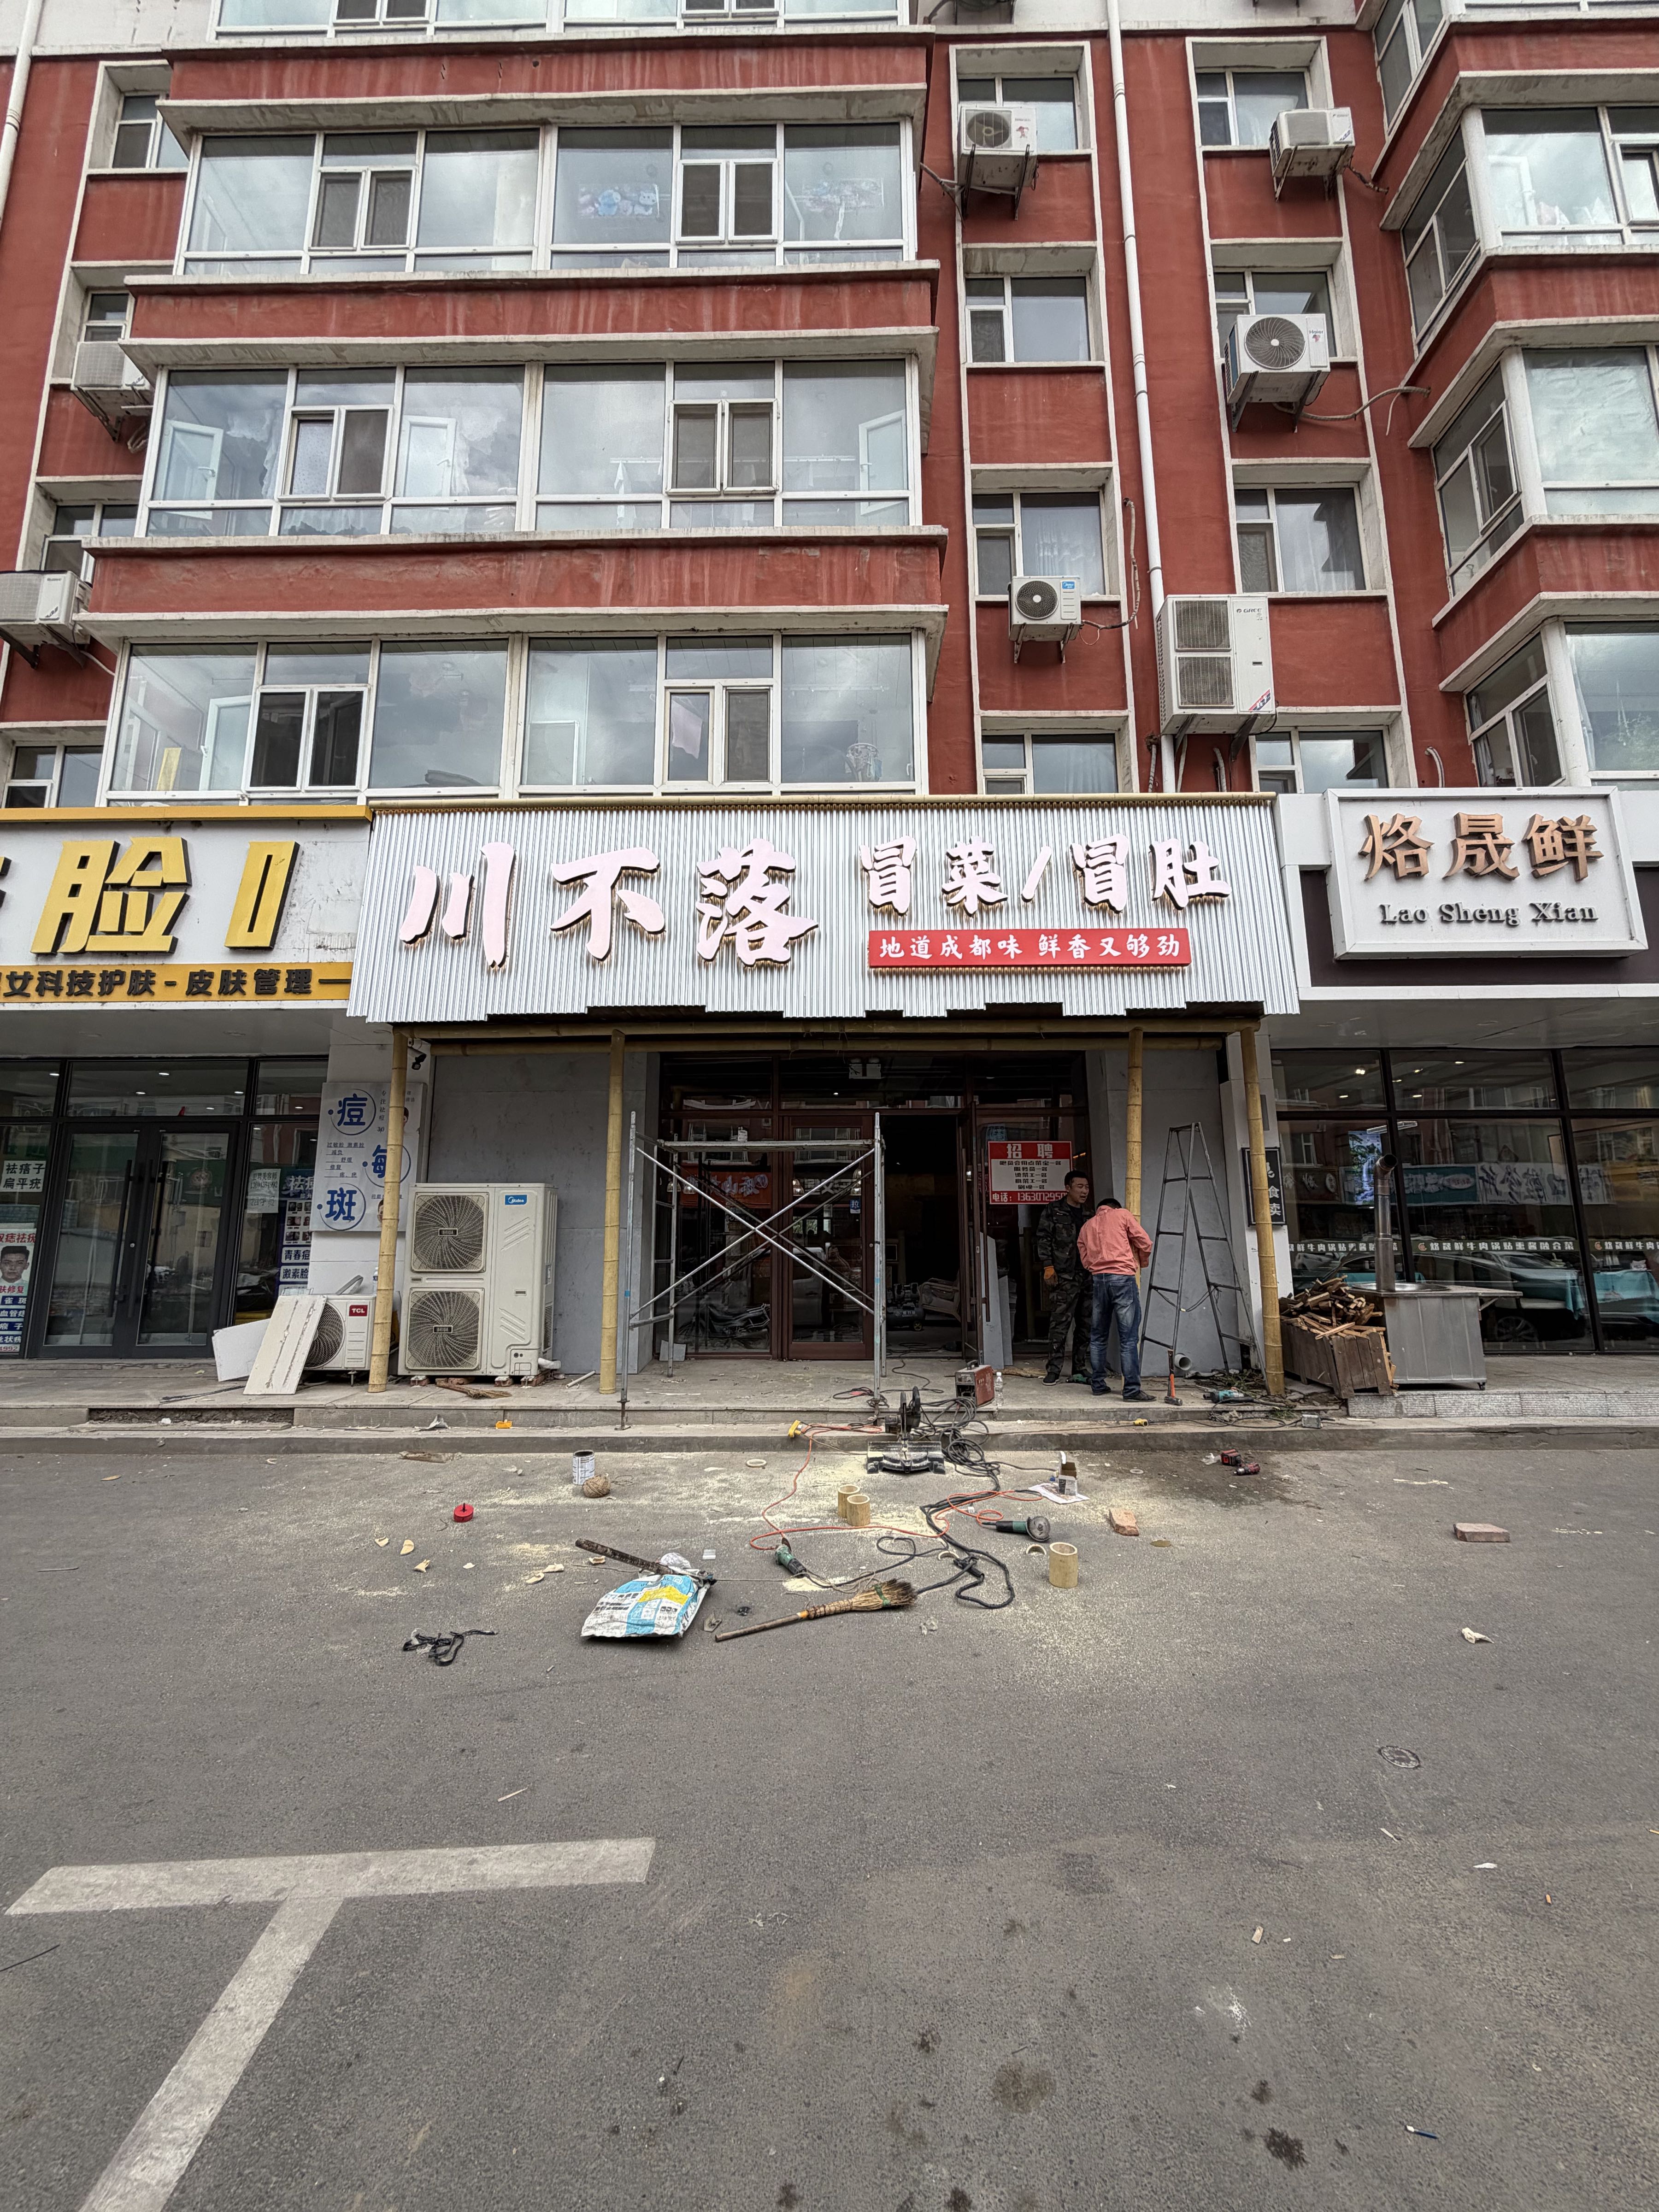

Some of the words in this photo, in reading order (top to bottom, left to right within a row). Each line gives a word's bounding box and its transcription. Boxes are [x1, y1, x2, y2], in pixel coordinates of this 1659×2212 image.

[1359, 812, 1605, 881] 烙晟鲜
[859, 833, 1231, 917] 冒菜/冒肚
[399, 838, 819, 969] 川不落
[1380, 904, 1430, 924] Lao
[1439, 902, 1519, 927] Sheng
[1529, 902, 1600, 924] Xian
[879, 934, 1023, 960] 地道成都味
[1038, 934, 1180, 959] 鲜香又够劲
[337, 1094, 368, 1126] 痘
[1006, 1143, 1053, 1159] 招聘
[3, 1177, 41, 1189] 扁平疣
[325, 1187, 357, 1221] 斑
[282, 1268, 308, 1279] 激素脸
